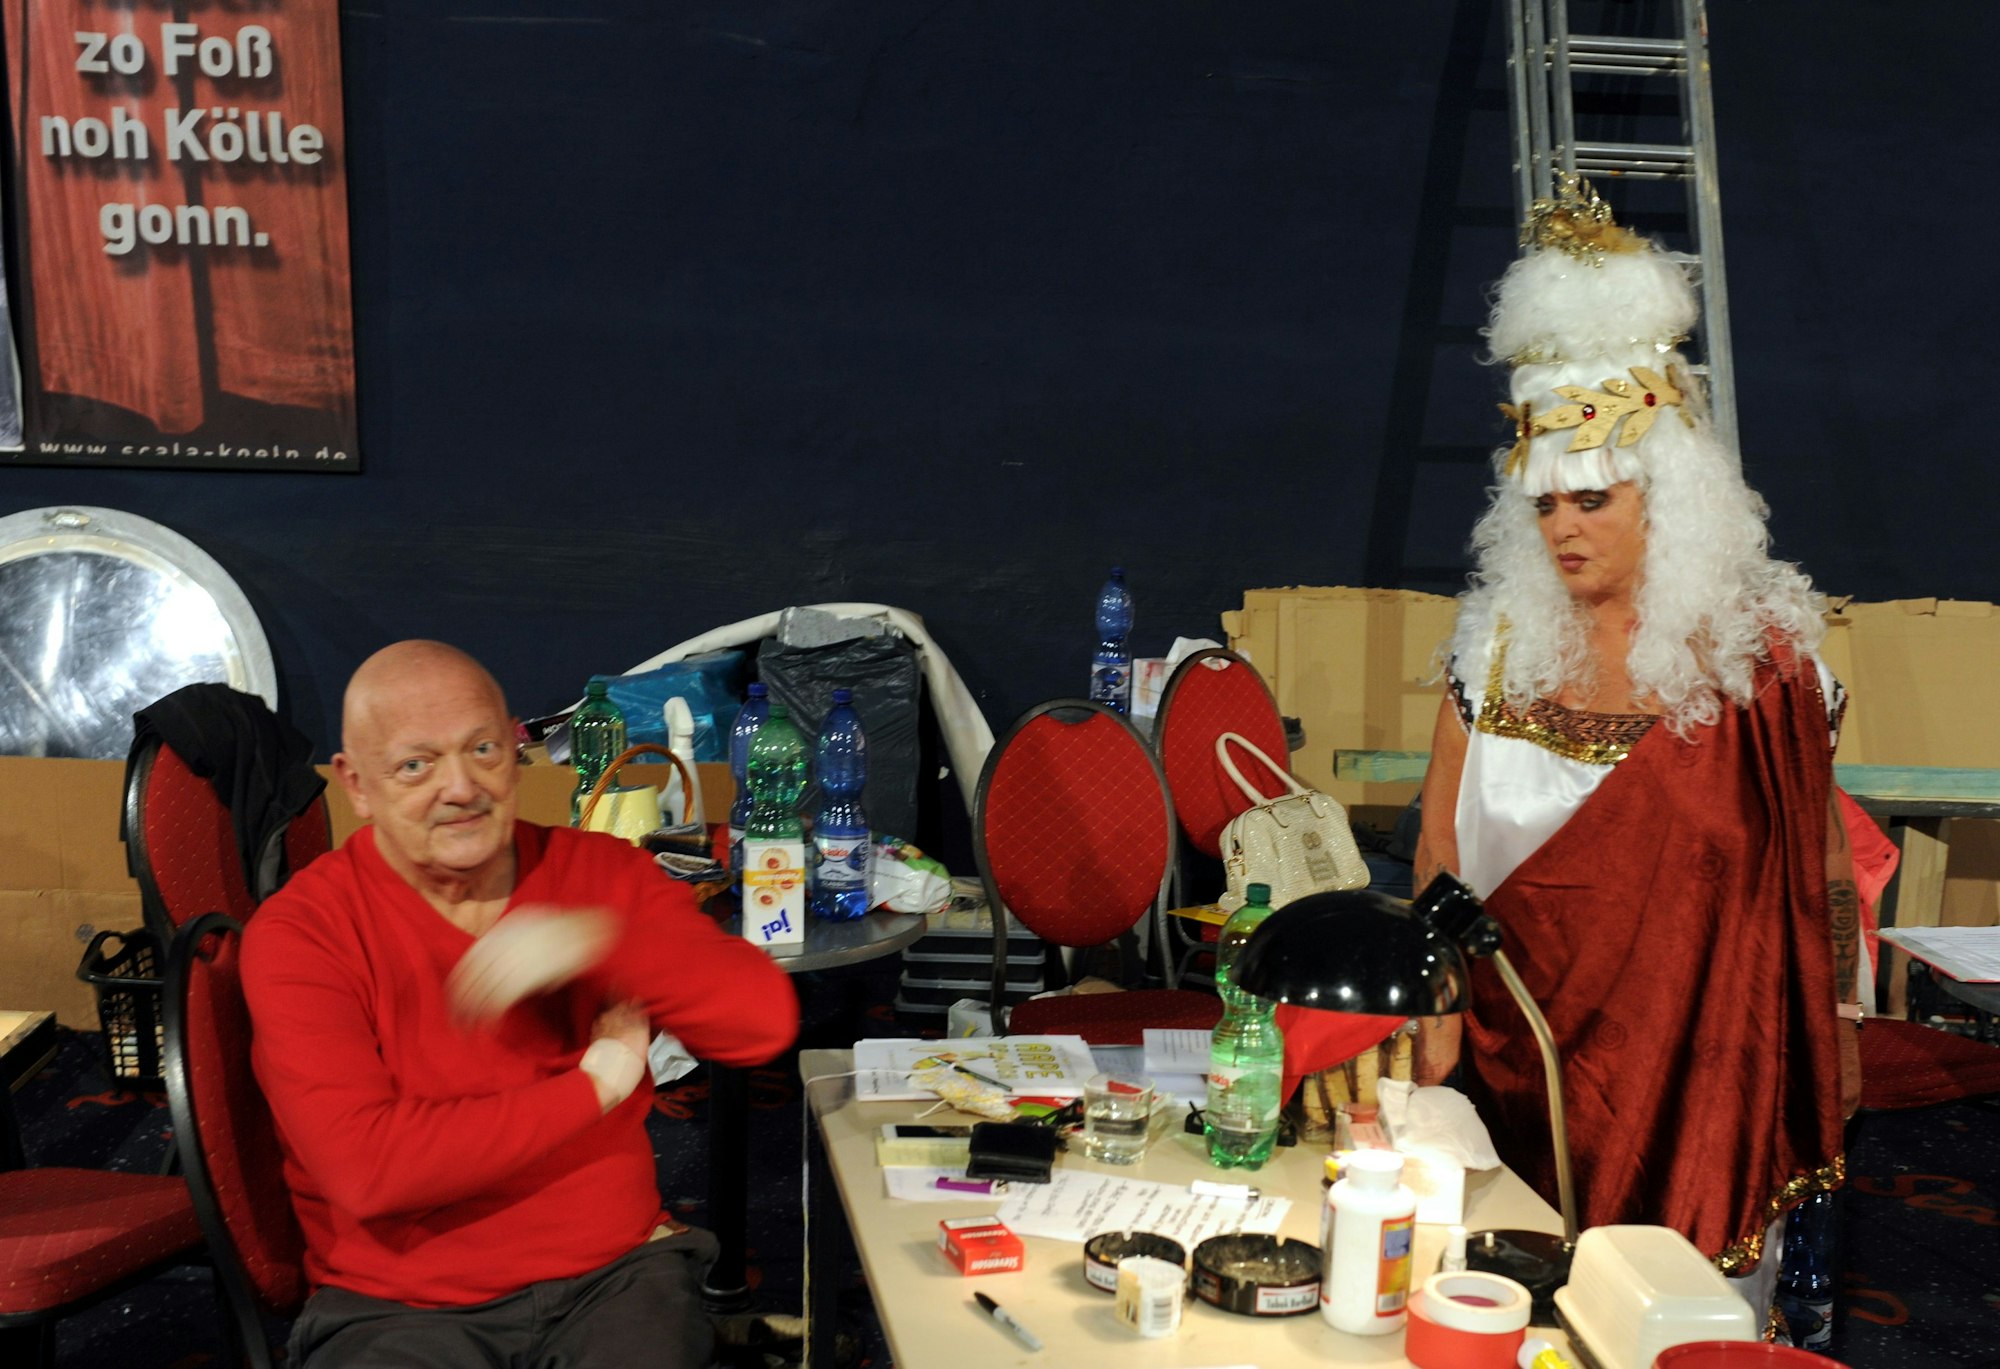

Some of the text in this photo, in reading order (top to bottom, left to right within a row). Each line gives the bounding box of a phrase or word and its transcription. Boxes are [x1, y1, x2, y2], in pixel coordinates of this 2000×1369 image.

[74, 22, 273, 79] zo Foß
[40, 105, 325, 165] noh Kölle
[100, 201, 270, 256] gonn.
[761, 908, 792, 942] ja!
[970, 1255, 1020, 1272] Stevenson
